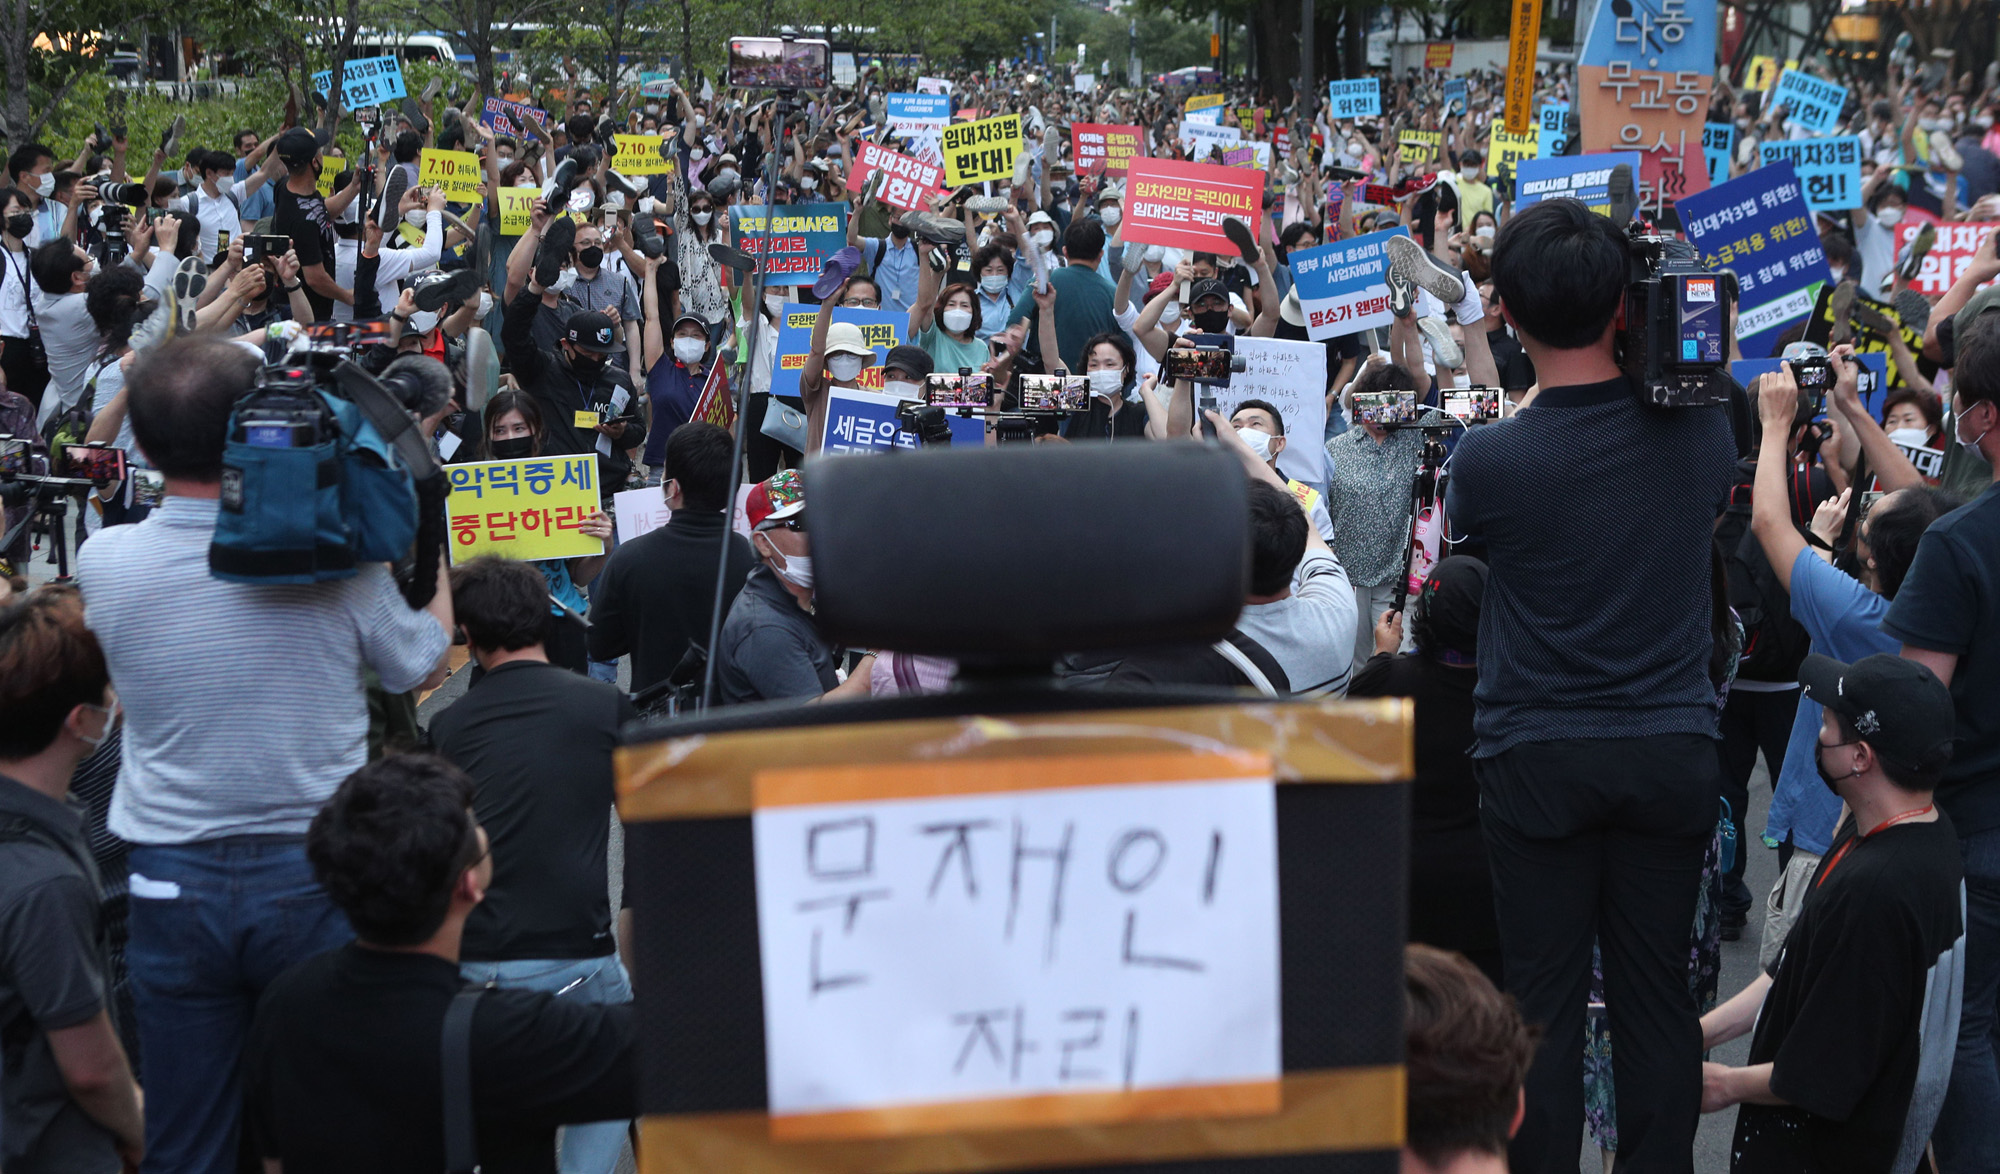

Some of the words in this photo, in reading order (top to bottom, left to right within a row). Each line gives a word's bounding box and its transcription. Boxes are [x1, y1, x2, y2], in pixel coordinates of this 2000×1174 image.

[316, 61, 378, 90] 임차3법
[1332, 81, 1377, 96] 임대차3법
[1600, 61, 1707, 114] 무교동
[1782, 73, 1842, 107] 임대차3법
[341, 82, 379, 107] 헌!
[1339, 98, 1373, 114] 위헌!
[619, 142, 645, 155] 7.10
[944, 118, 1019, 149] 임대차3법
[428, 158, 455, 175] 7.10
[863, 145, 938, 188] 임대차3법
[956, 147, 1013, 180] 반대!
[1135, 181, 1193, 202] 임차인만
[1194, 188, 1253, 211] 국민이냐,
[1797, 173, 1847, 204] 헌!
[1133, 201, 1190, 222] 임대인도
[1688, 197, 1759, 239] 임대차3법
[1761, 183, 1799, 210] 위헌!
[1704, 231, 1766, 269] 소급적용
[1769, 216, 1809, 243] 위헌!
[753, 256, 821, 275] 놔라!!
[1297, 258, 1319, 274] 정부
[1322, 251, 1344, 268] 시책
[1346, 242, 1379, 262] 충실히
[1328, 260, 1382, 284] 사업자에게
[1738, 273, 1756, 294] 권
[1757, 258, 1788, 285] 침해
[1789, 247, 1824, 271] 위헌!
[1688, 283, 1713, 291] MBN
[1310, 304, 1352, 328] 말소가
[1786, 295, 1809, 313] 반대
[450, 459, 592, 499] 악덕증세
[794, 810, 1224, 998] 문재인
[950, 1003, 1140, 1092] 자리
